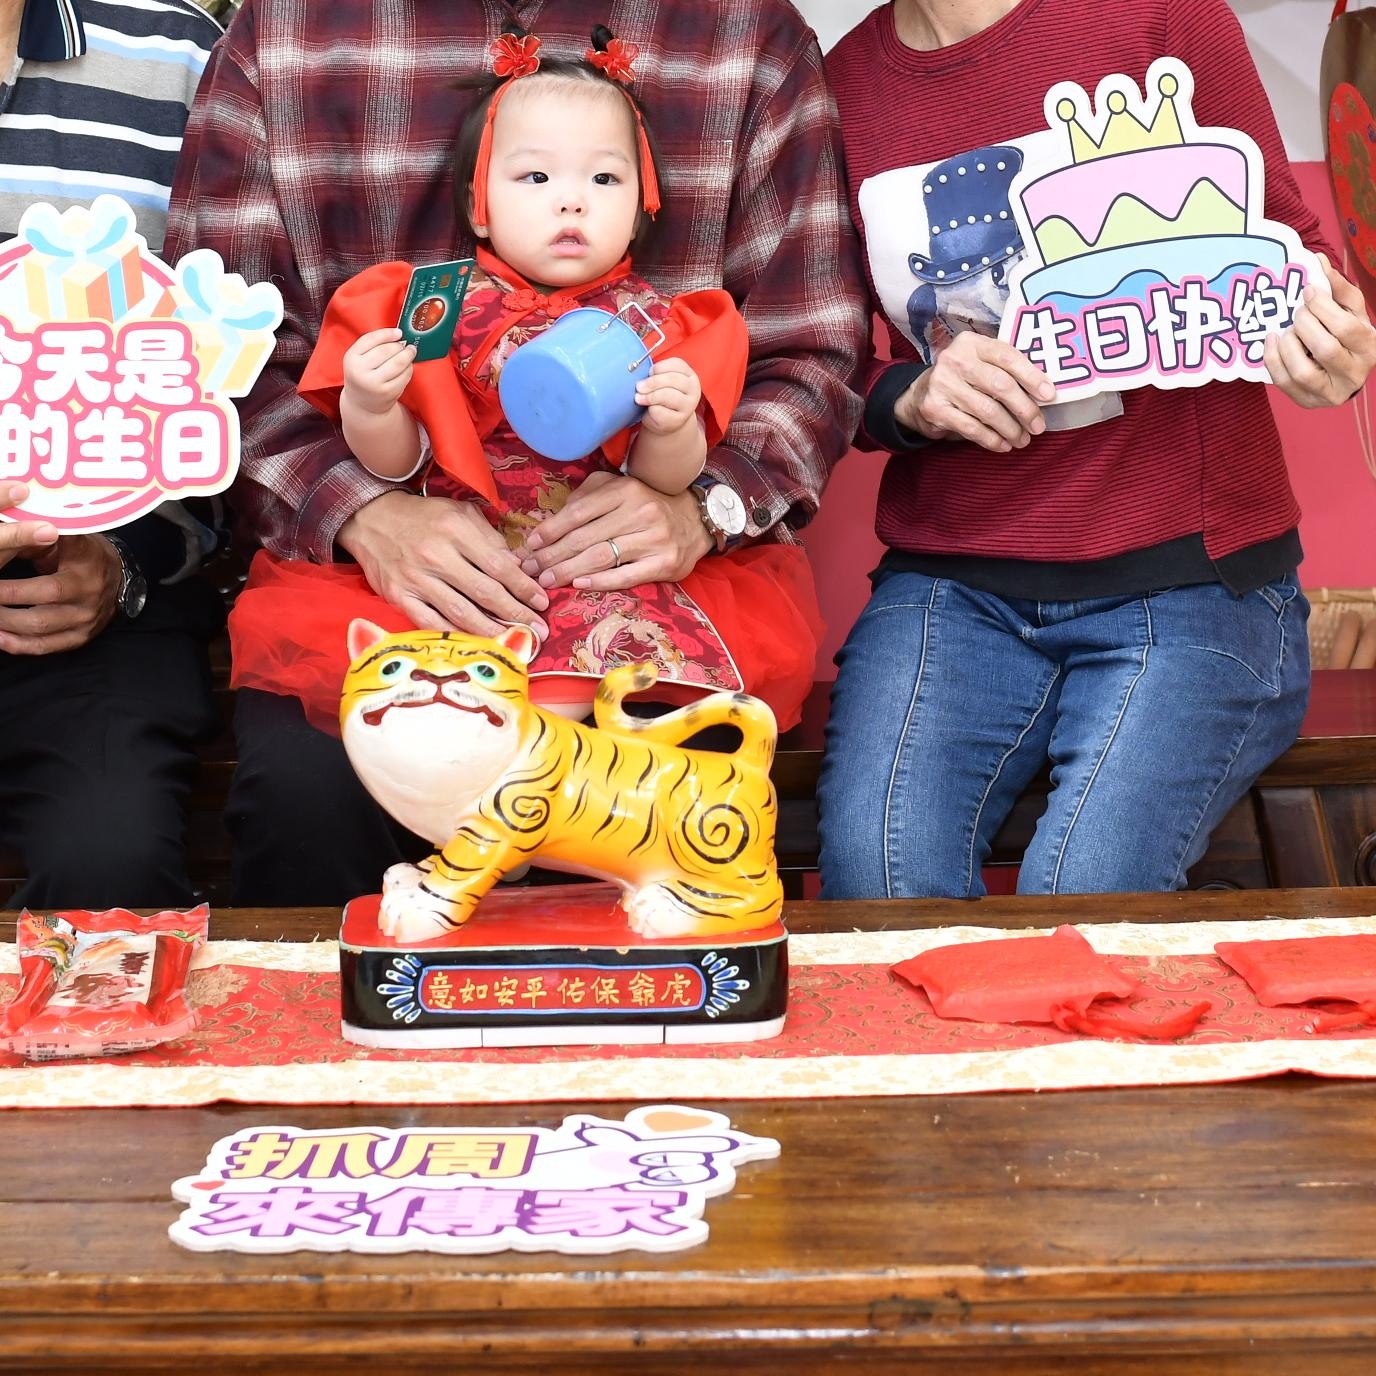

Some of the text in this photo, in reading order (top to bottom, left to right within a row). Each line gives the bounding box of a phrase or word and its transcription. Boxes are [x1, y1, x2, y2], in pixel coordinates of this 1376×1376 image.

[223, 1132, 540, 1180] 抓周
[188, 1185, 689, 1238] 來傳家
